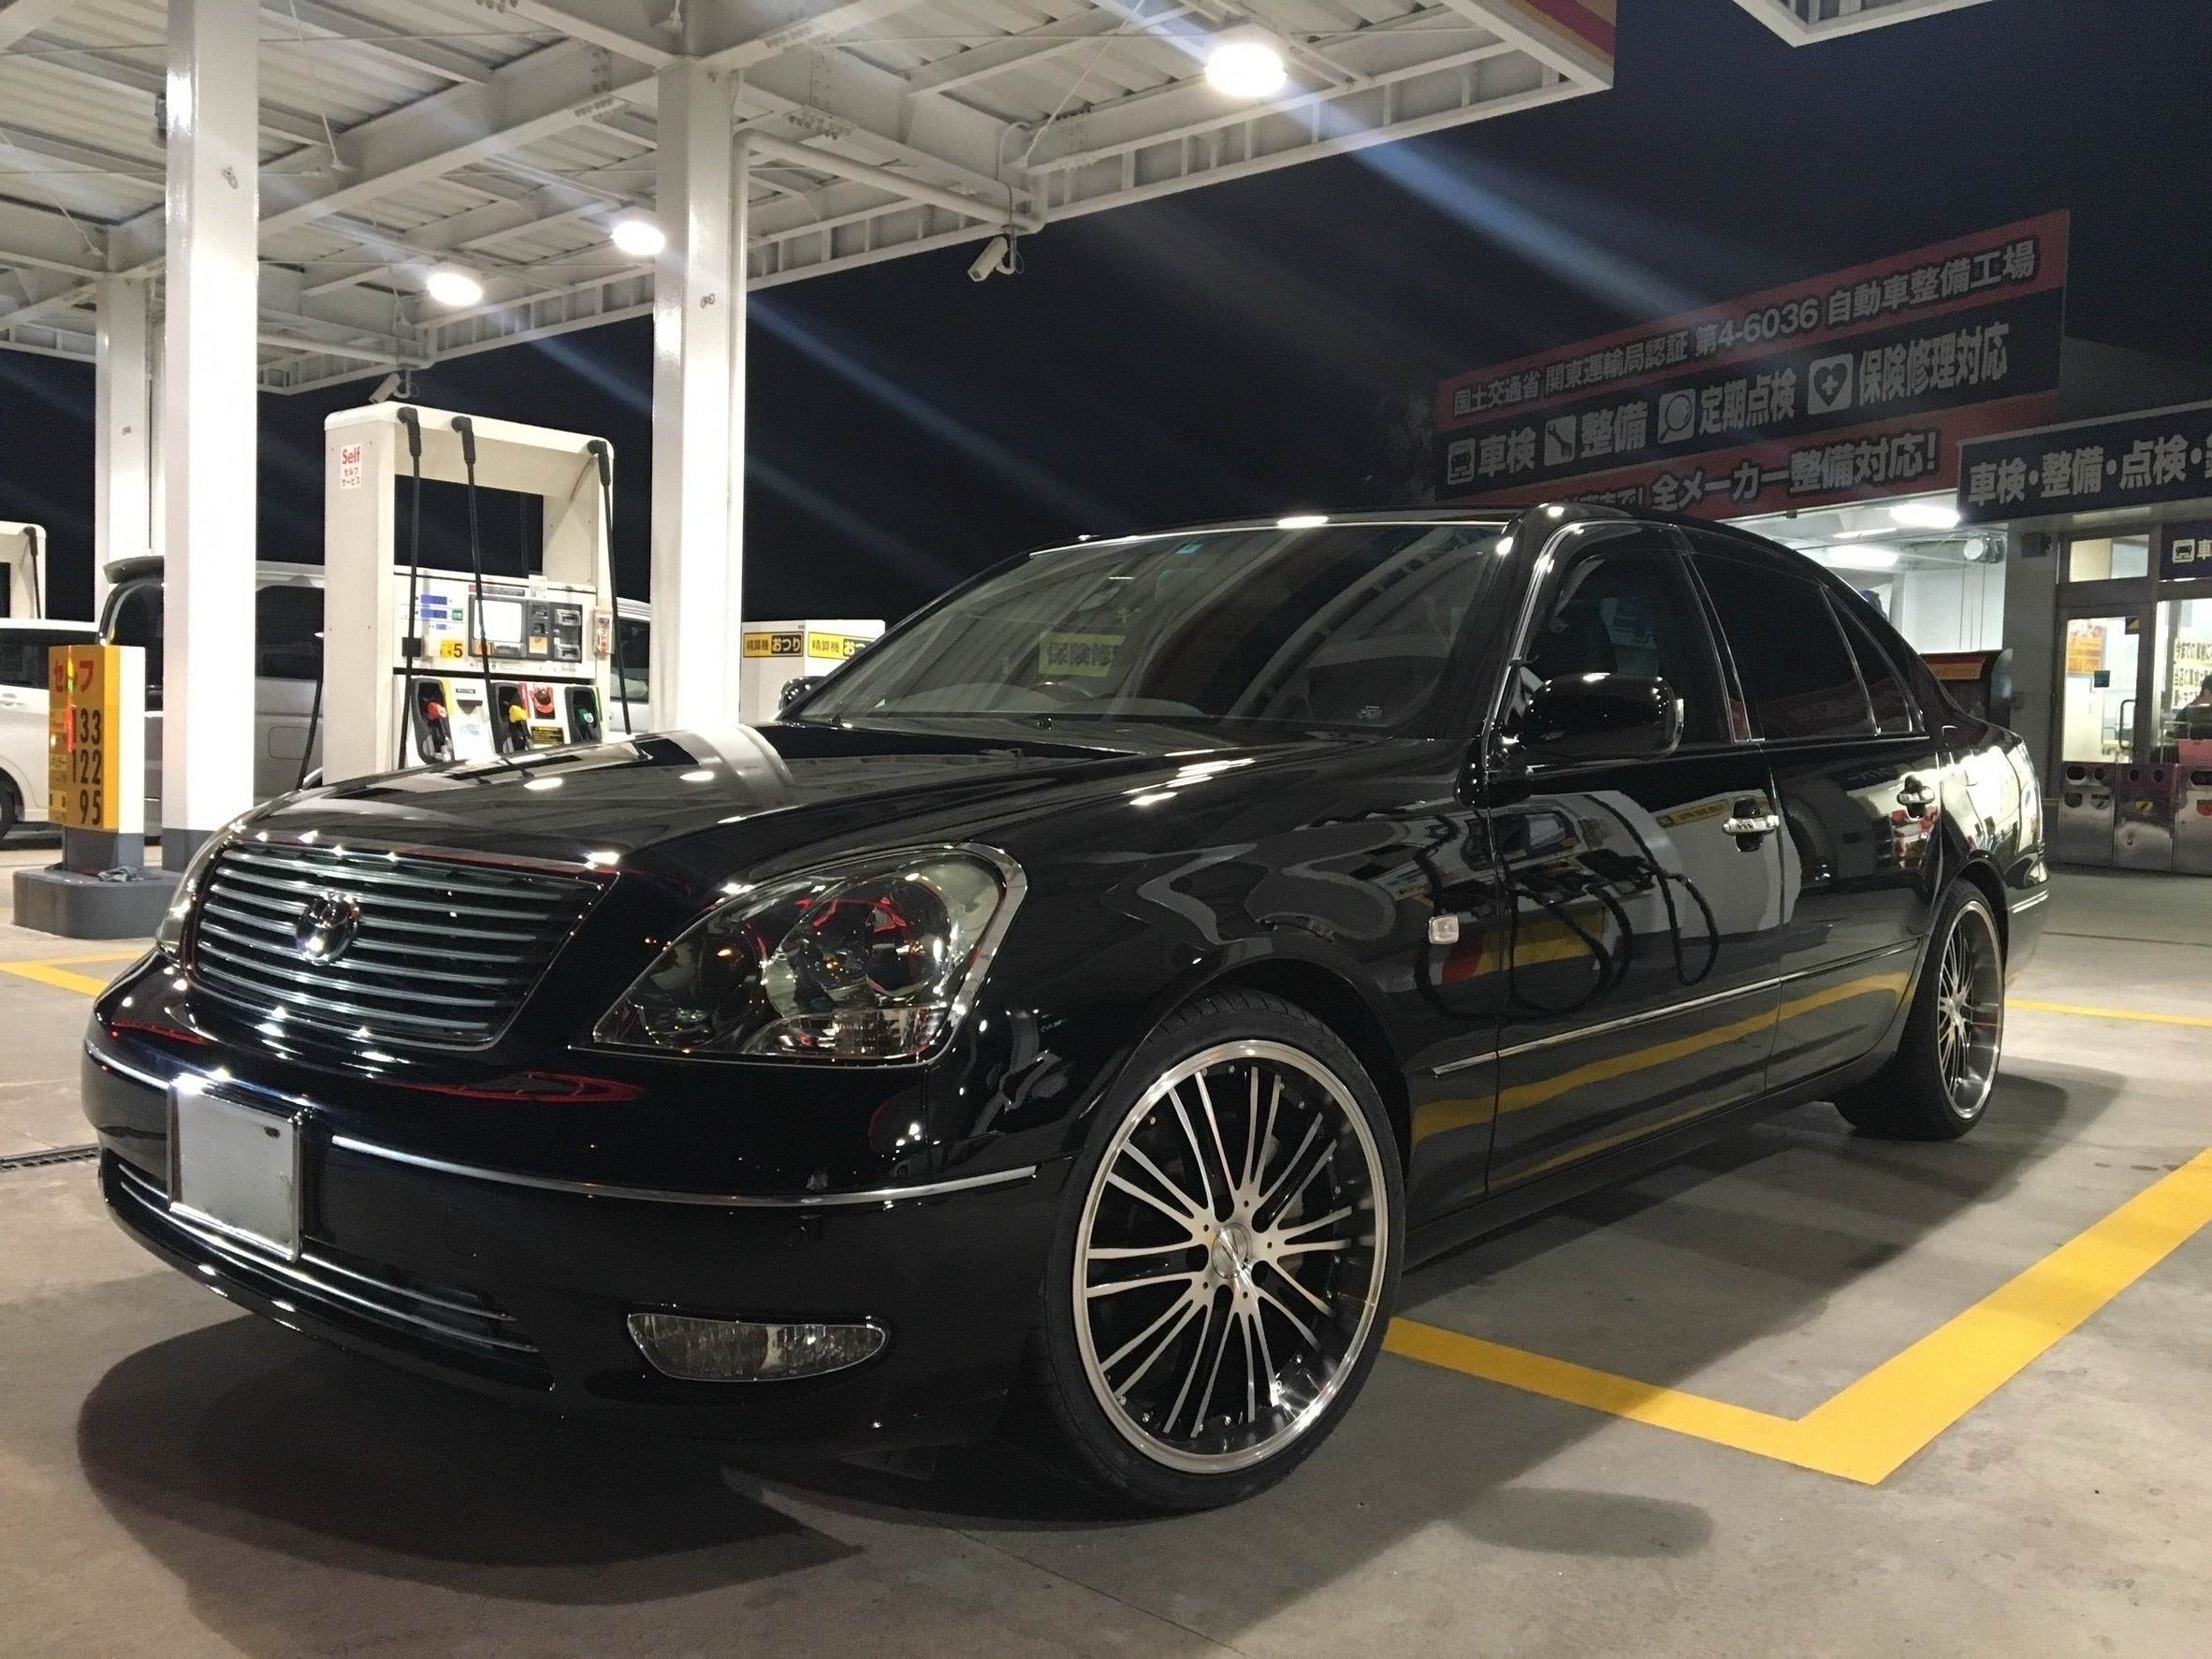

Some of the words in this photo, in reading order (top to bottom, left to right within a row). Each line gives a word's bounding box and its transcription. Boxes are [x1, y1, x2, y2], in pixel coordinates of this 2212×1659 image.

[1454, 371, 1541, 415] 国土交通省
[1545, 330, 1688, 393] 関東運輸局認証
[1695, 298, 1819, 357] 第4-6036
[1827, 240, 2034, 326] 自動車整備工場
[1478, 426, 1537, 478] 車検
[1580, 400, 1649, 458] 整備
[1698, 368, 1797, 434] 定期点検
[1858, 321, 2010, 406] 保険修理対応
[342, 445, 360, 465] Self
[1652, 431, 1936, 513] 全メーカー整備対応!
[1969, 432, 2212, 507] 車検・整備・点検・
[454, 643, 463, 658] 5
[772, 635, 801, 652] おつり
[811, 639, 840, 653] 精算機
[71, 749, 101, 785] 122
[79, 789, 101, 825] 95
